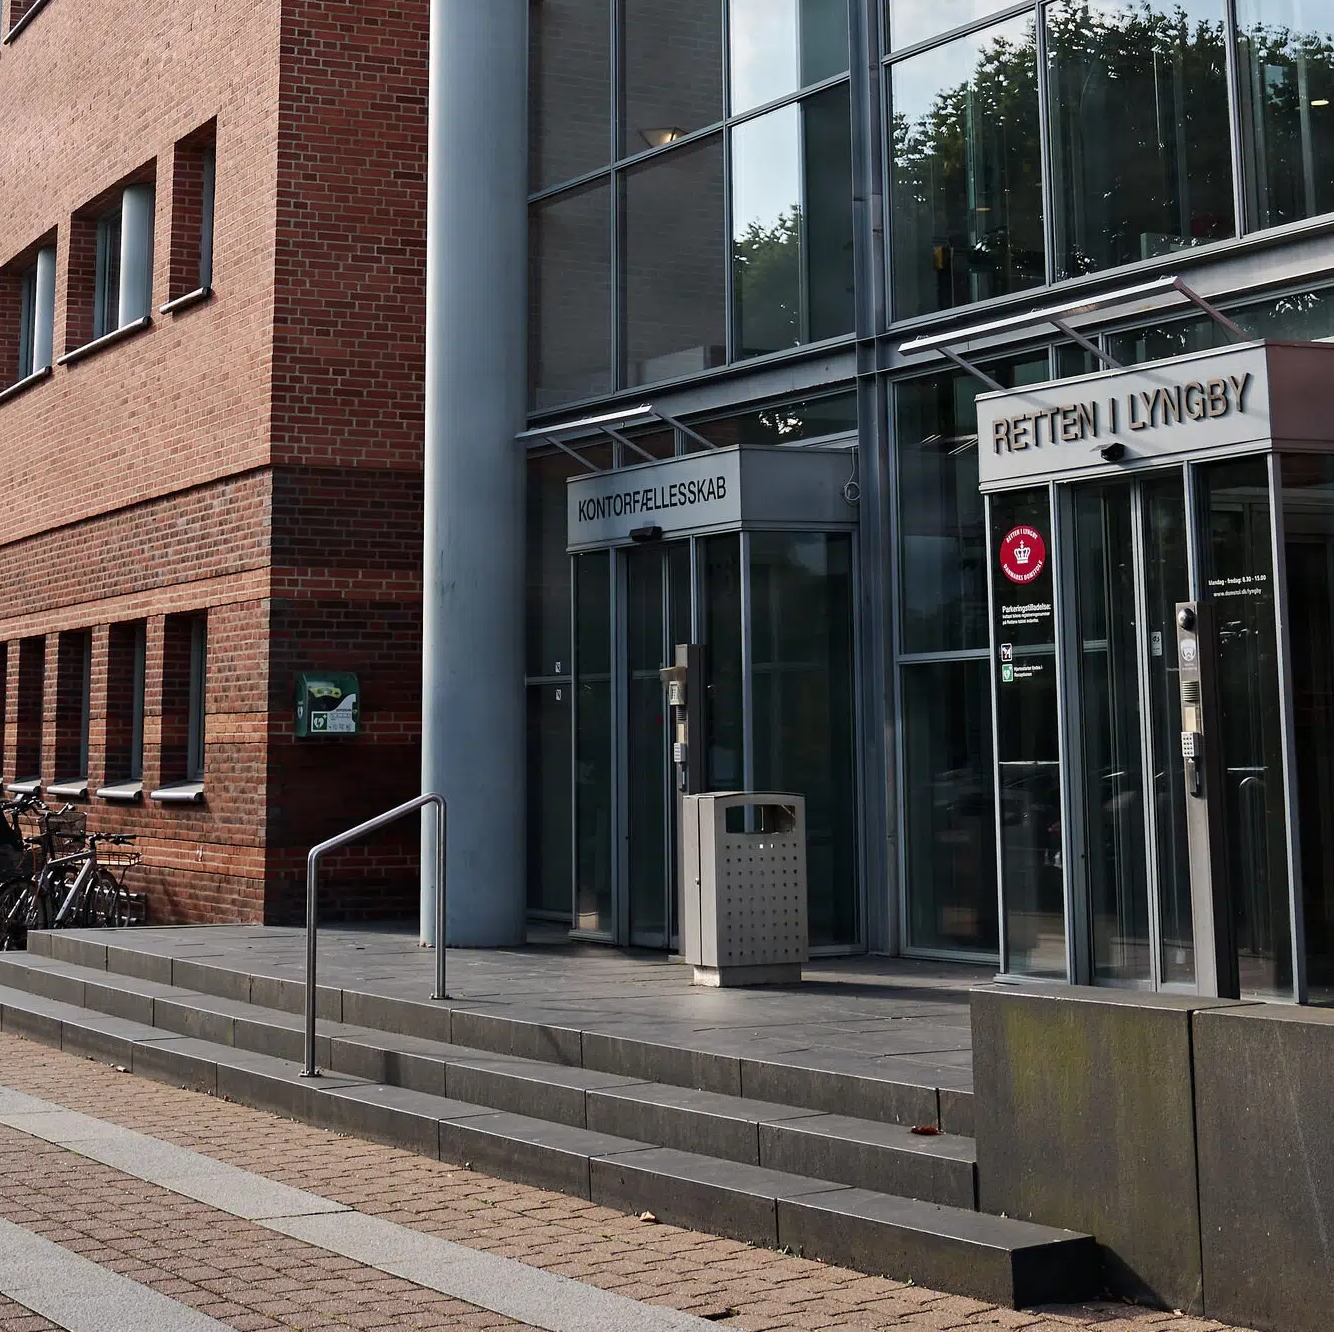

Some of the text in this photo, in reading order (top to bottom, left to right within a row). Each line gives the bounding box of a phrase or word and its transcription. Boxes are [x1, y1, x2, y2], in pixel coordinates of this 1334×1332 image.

[992, 372, 1251, 455] RETTEN I LYNGBY
[578, 475, 727, 522] KONTORFÆLLESSKAB
